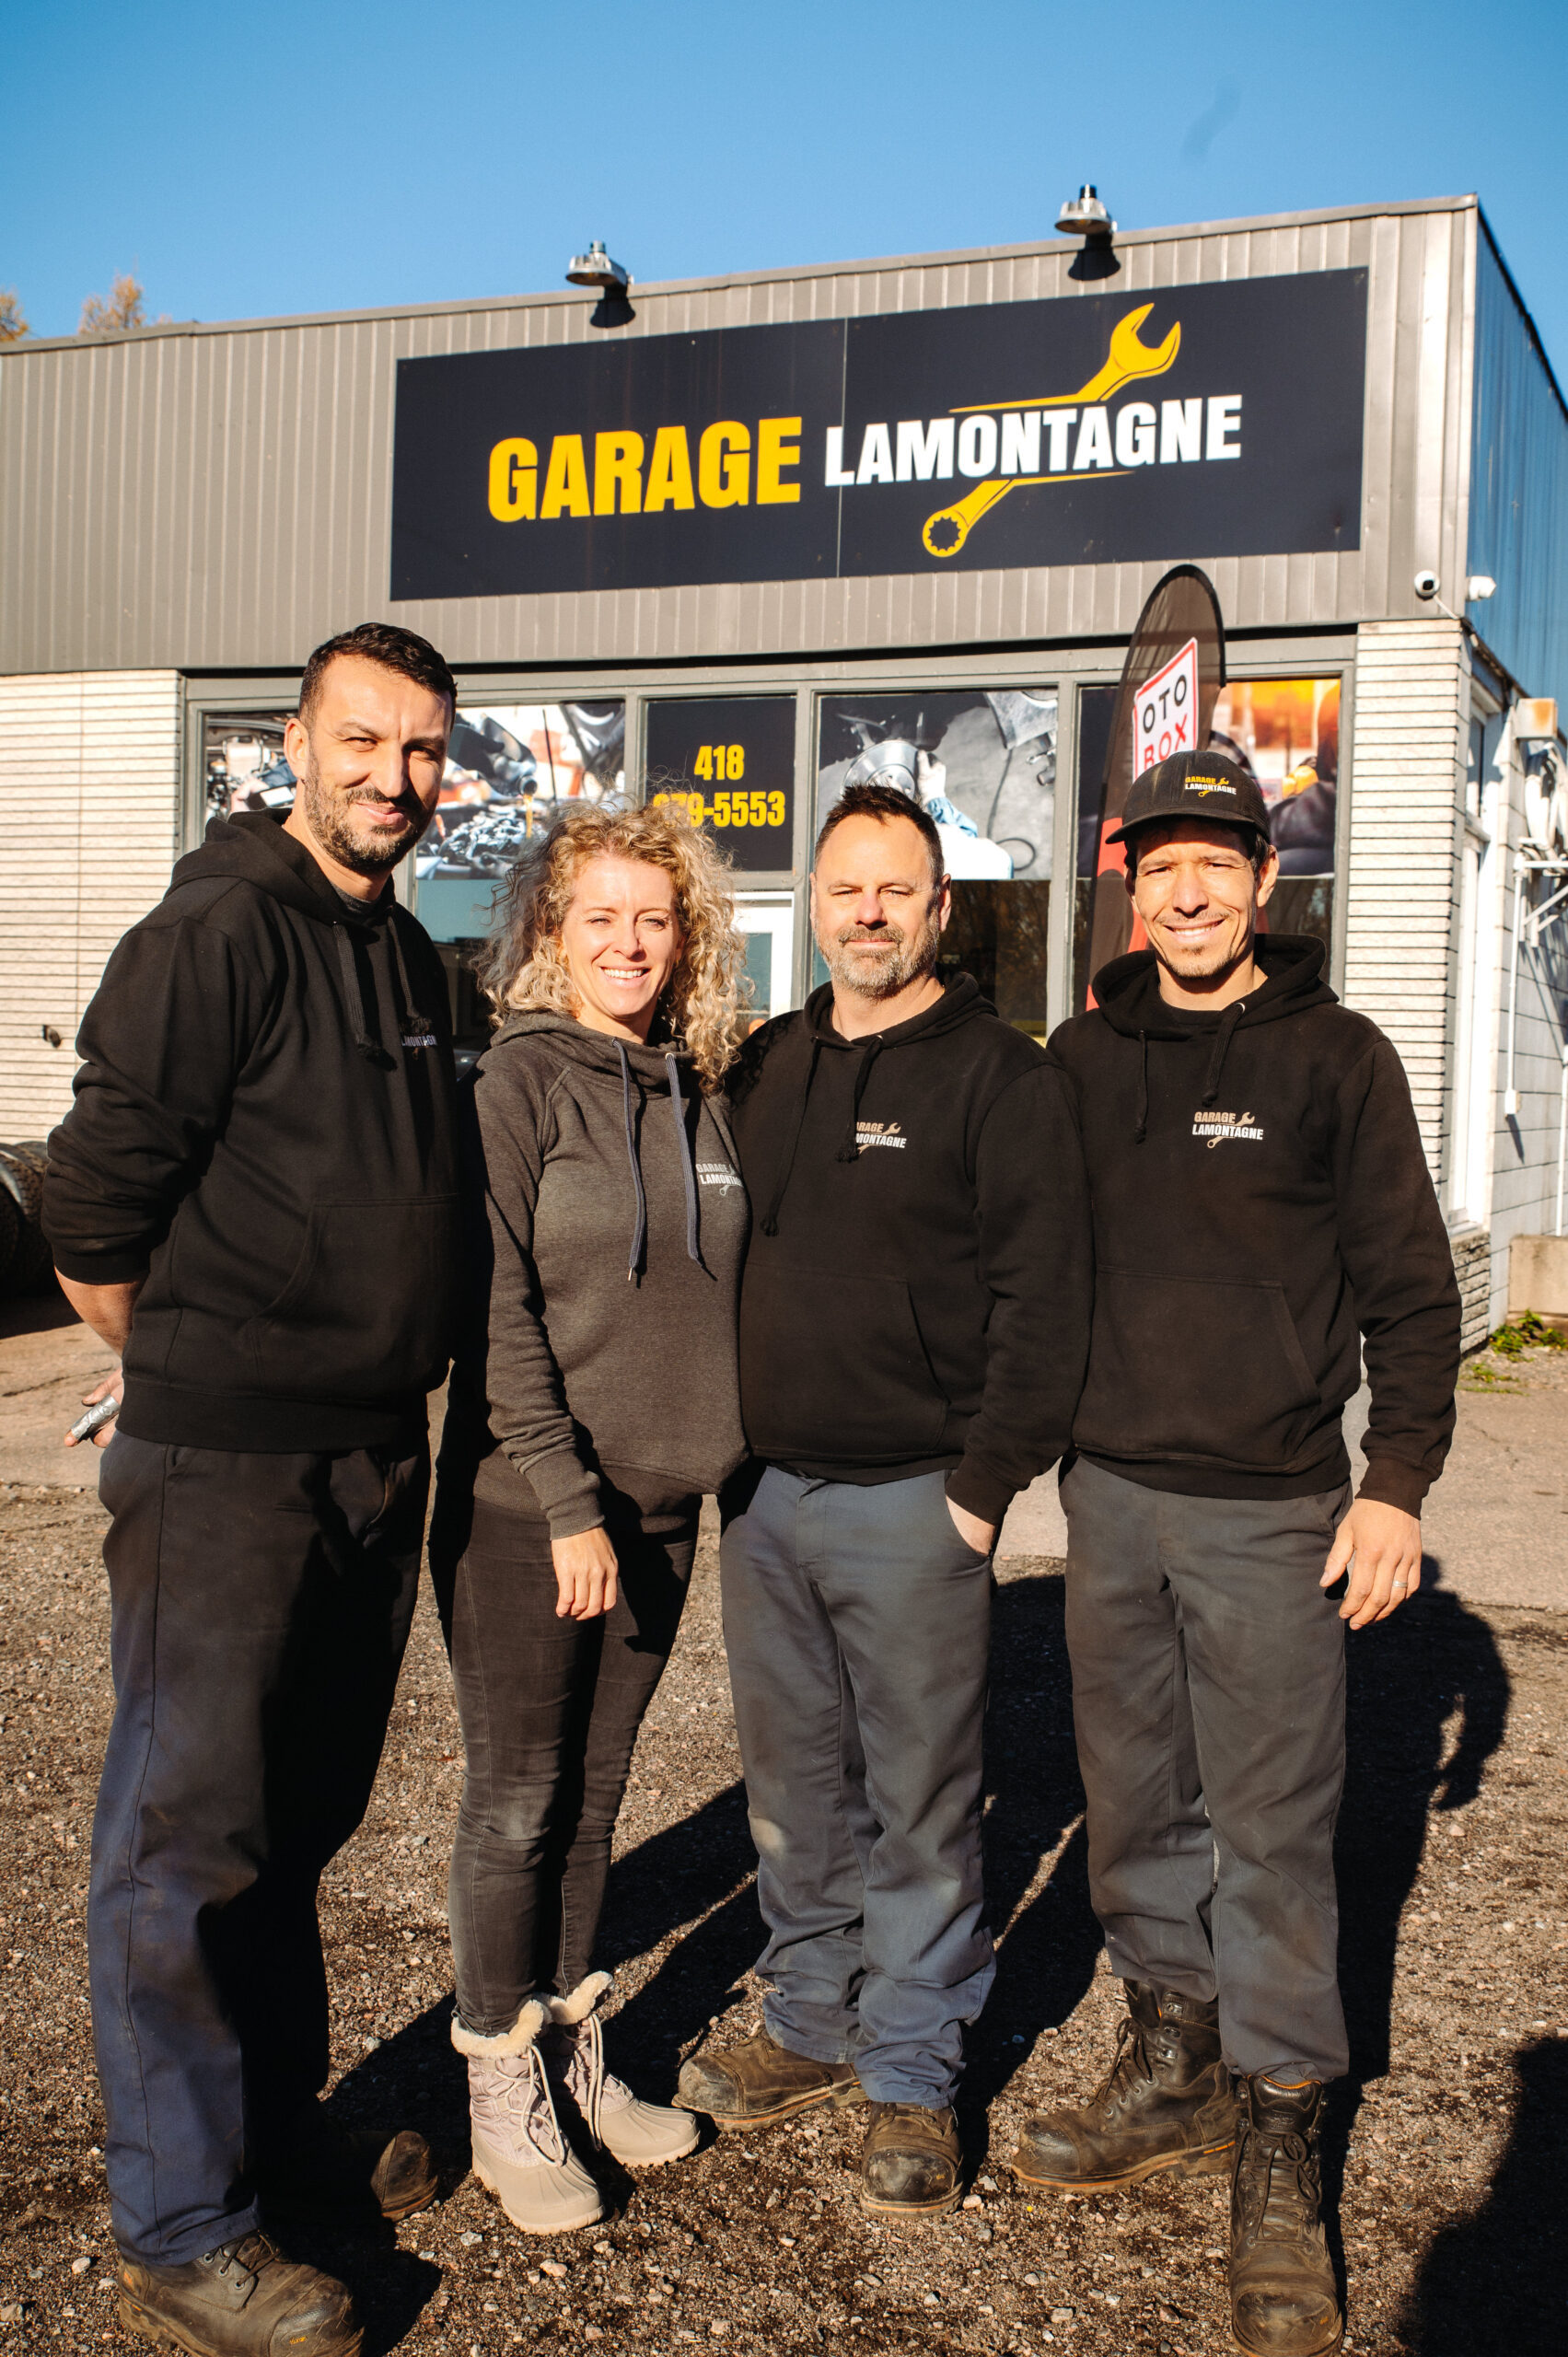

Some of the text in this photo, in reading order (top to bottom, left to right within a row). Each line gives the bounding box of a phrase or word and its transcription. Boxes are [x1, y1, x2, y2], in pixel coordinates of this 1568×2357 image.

[487, 394, 1243, 523] GARAGE LAMONTAGNE
[1143, 674, 1187, 734] OTO
[1144, 713, 1188, 772] BOX
[694, 744, 745, 781] 418
[1185, 776, 1216, 784] GARAGE
[1185, 783, 1237, 795] LAMONTAGNE
[652, 790, 785, 828] 79-5553
[1194, 1111, 1236, 1124] GARAGE
[855, 1132, 907, 1148] MONTAGNE
[1191, 1123, 1263, 1140] LAMONTAGNE
[695, 1163, 729, 1173] GARAGE
